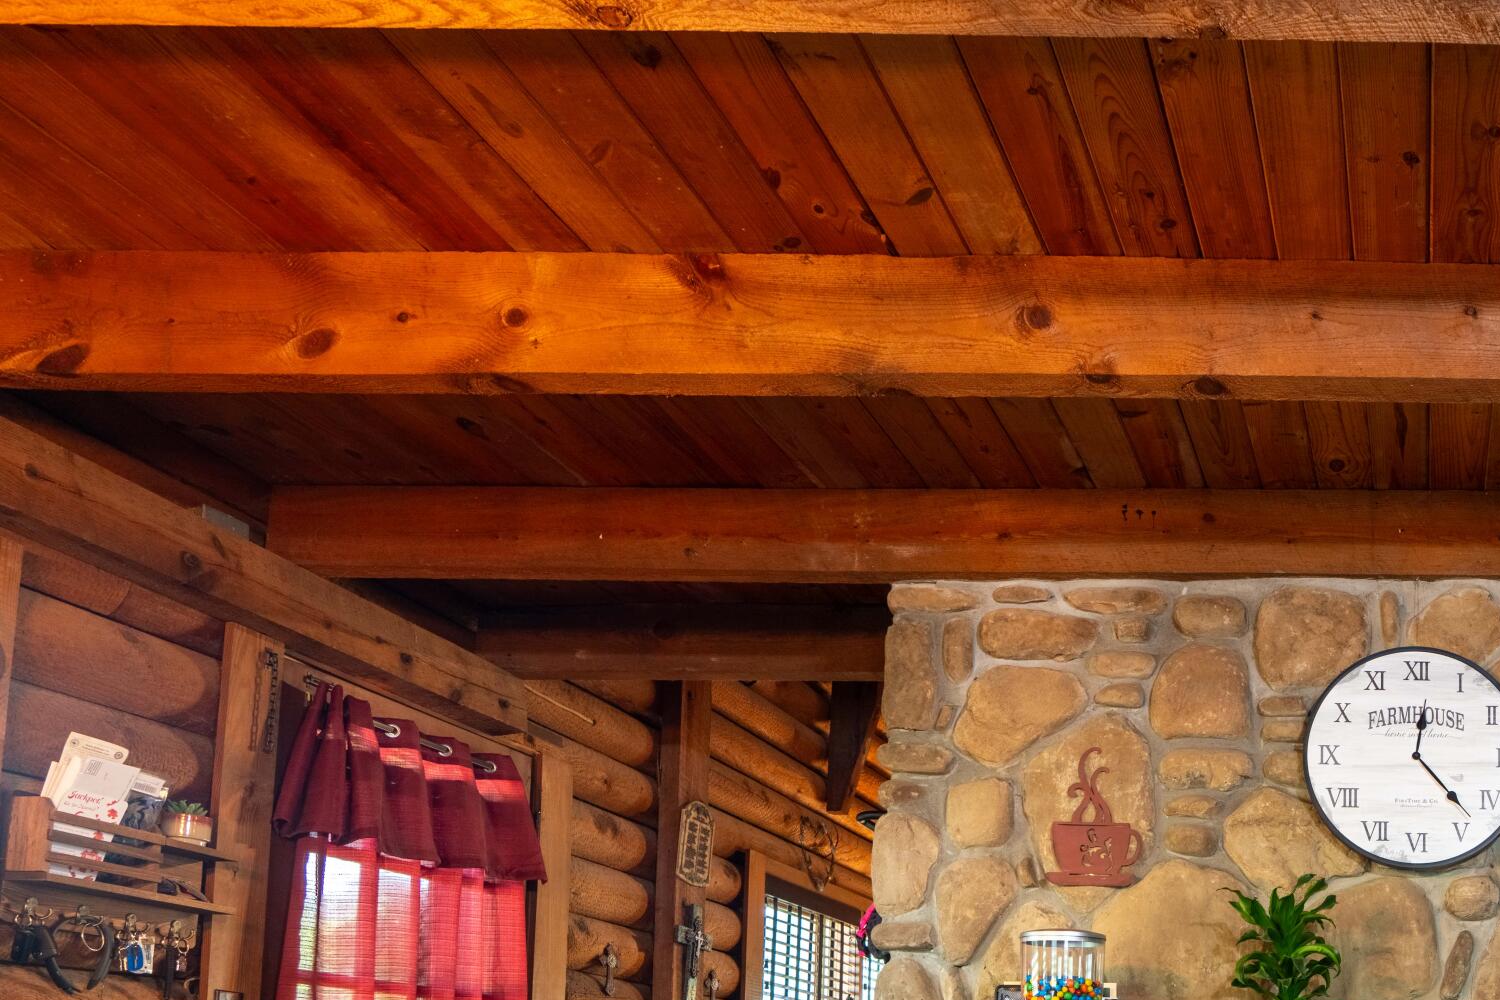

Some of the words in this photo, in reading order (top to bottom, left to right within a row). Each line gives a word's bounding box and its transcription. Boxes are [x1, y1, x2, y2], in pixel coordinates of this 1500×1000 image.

[1364, 670, 1386, 690] XI
[1403, 661, 1430, 681] XII
[1456, 673, 1465, 693] I
[1334, 702, 1351, 723] X
[1368, 706, 1465, 732] FARMHOUSE
[1485, 705, 1498, 725] II
[1318, 745, 1341, 765] IX
[1326, 787, 1359, 808] VIII
[1361, 820, 1390, 841] VII
[1452, 822, 1470, 842] V
[1405, 832, 1429, 853] VI
